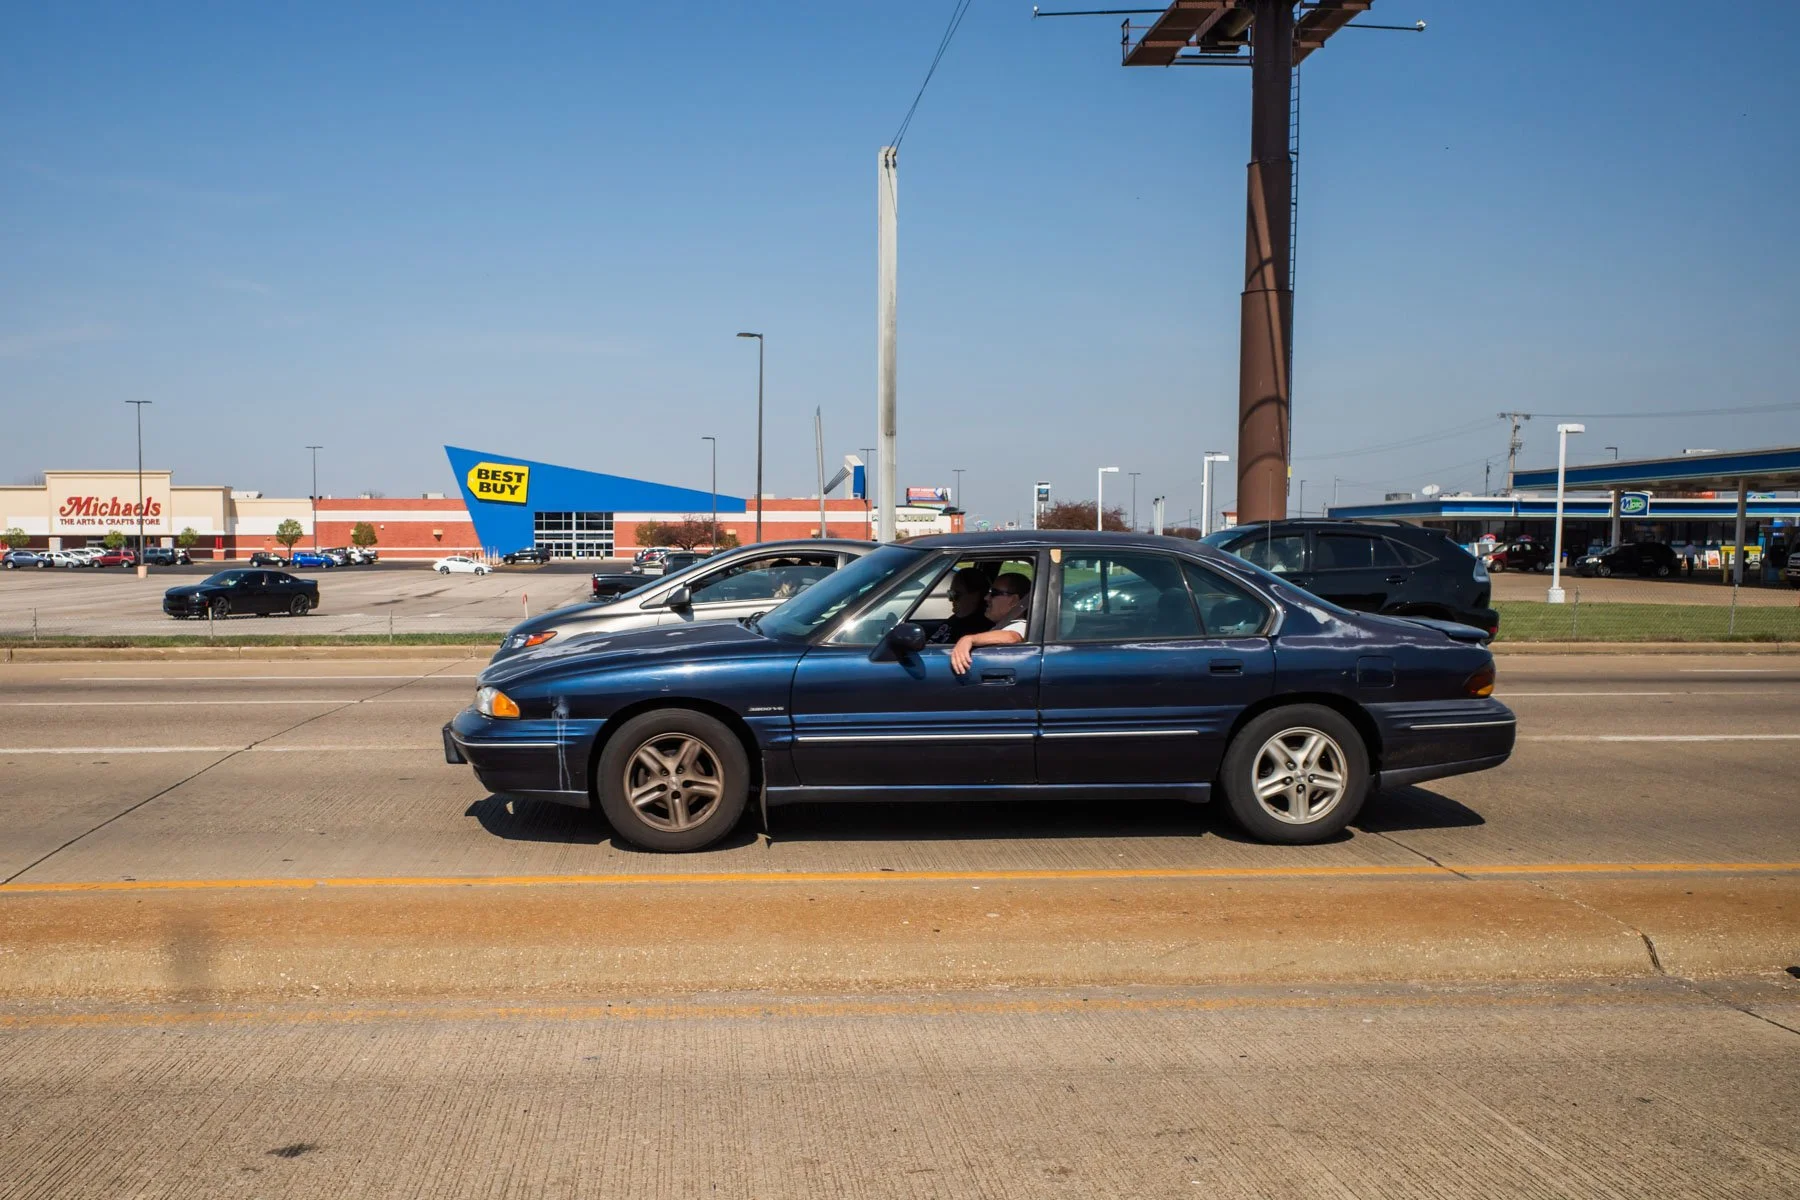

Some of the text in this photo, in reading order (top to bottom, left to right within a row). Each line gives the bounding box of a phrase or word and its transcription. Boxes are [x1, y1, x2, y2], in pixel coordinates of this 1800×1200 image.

[477, 468, 525, 483] BEST
[478, 482, 520, 495] BUY
[59, 496, 161, 517] Michaels
[60, 518, 160, 526] THE ARTS & CRAFTS STORE
